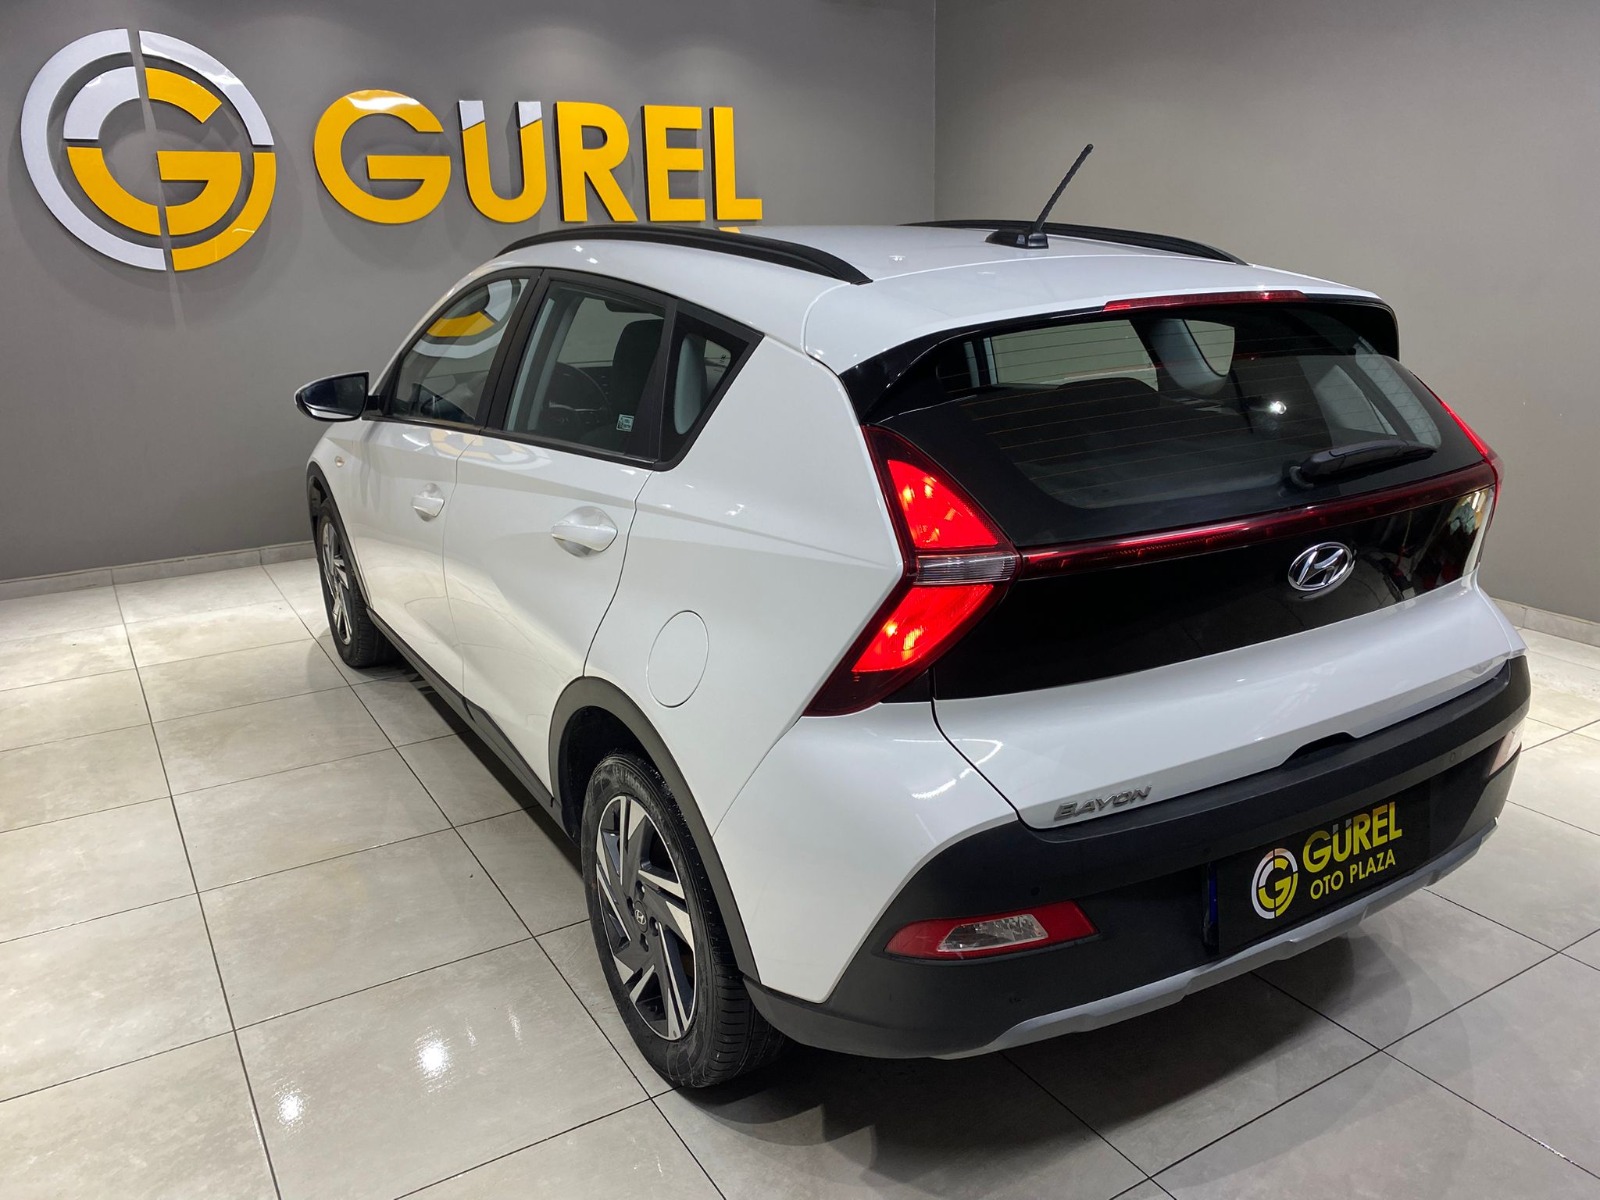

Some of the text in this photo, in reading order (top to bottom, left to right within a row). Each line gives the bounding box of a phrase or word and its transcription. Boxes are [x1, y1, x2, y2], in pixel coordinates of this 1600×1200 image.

[1053, 785, 1152, 821] BAYON
[1310, 848, 1396, 900] OTO PLAZA
